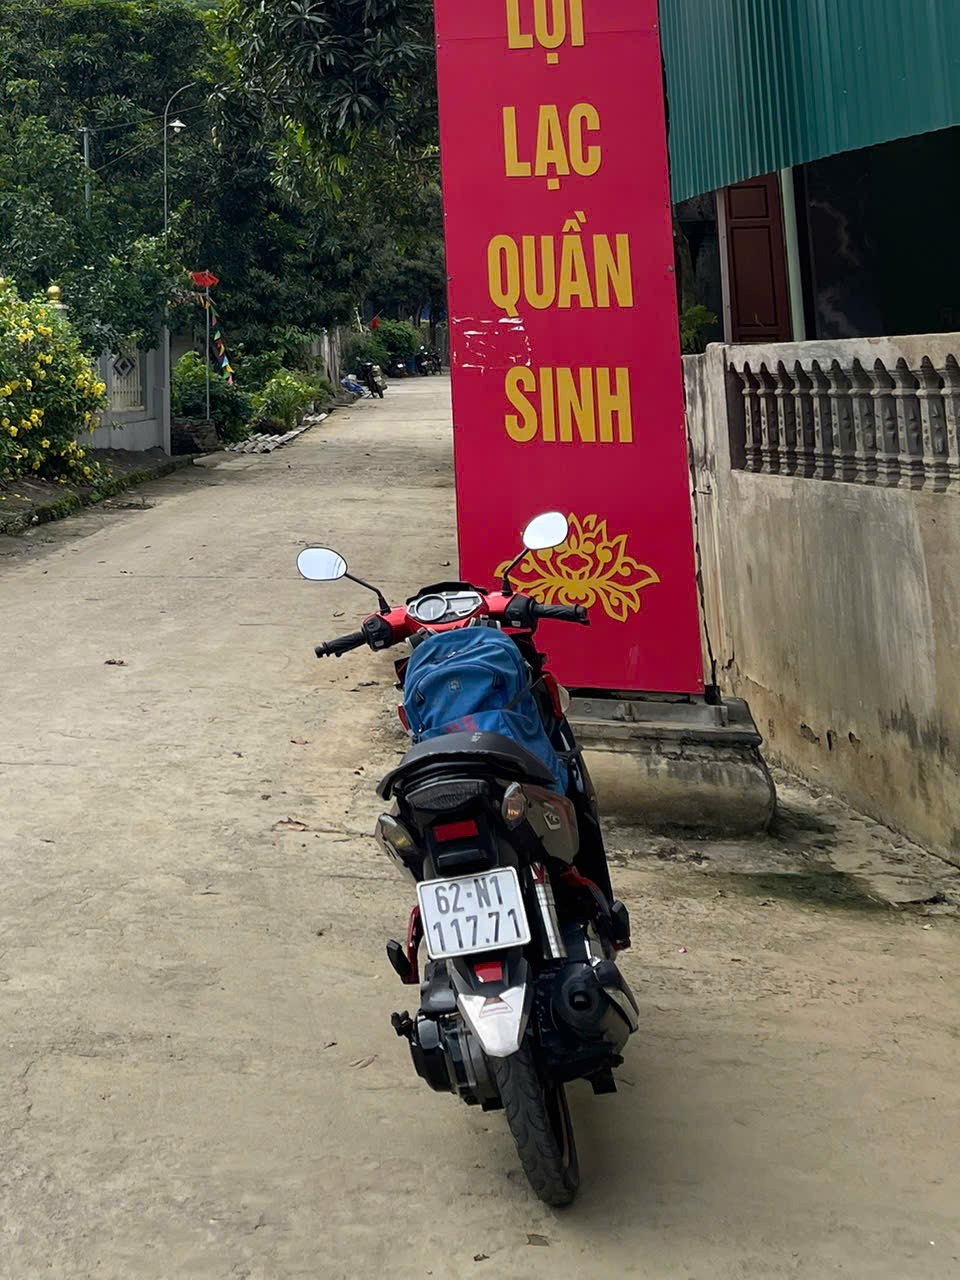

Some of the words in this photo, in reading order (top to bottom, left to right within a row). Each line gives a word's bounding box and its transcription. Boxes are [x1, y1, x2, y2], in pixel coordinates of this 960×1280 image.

[502, 102, 602, 190] LẠC
[487, 211, 634, 318] QUẦN
[505, 365, 634, 443] SINH
[433, 908, 521, 951] 117.71
